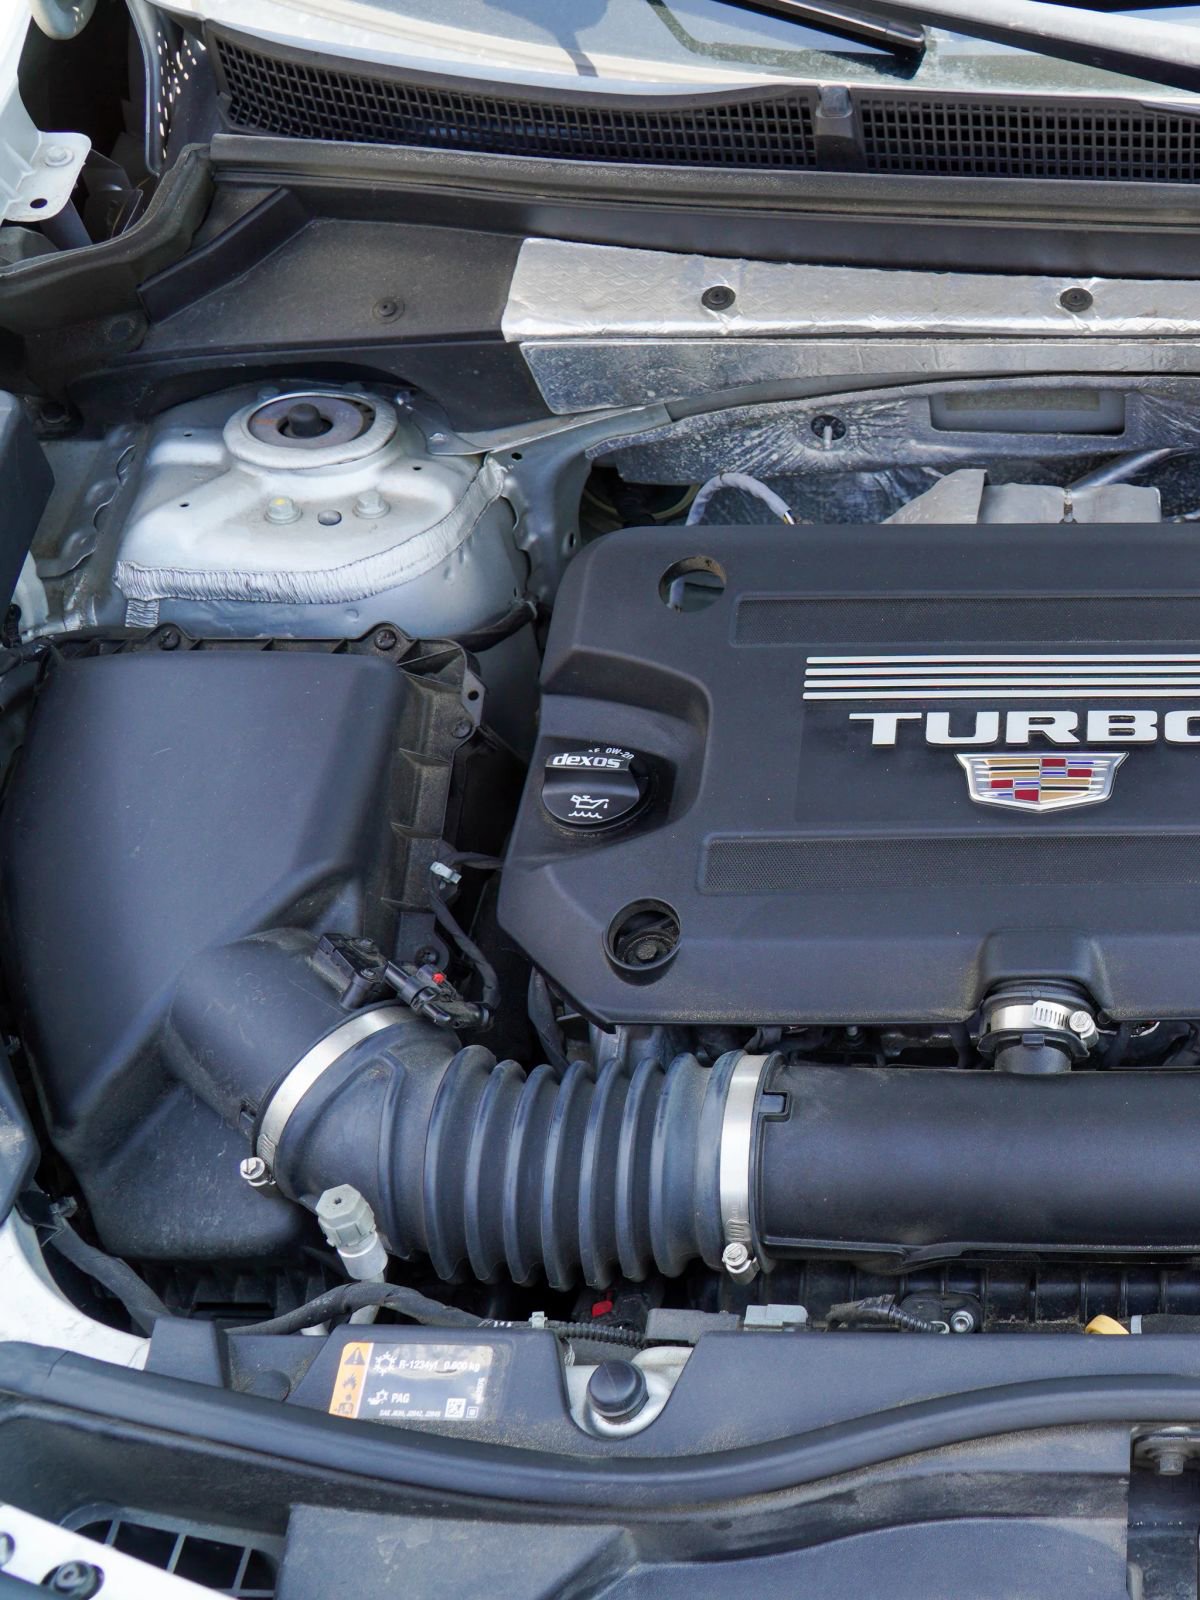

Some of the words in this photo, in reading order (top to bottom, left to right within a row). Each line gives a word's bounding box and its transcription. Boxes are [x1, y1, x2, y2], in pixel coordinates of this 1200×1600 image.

[552, 752, 624, 769] dexos
[399, 1360, 437, 1371] R-1234yf
[468, 1361, 481, 1373] kg
[391, 1393, 411, 1404] PAG
